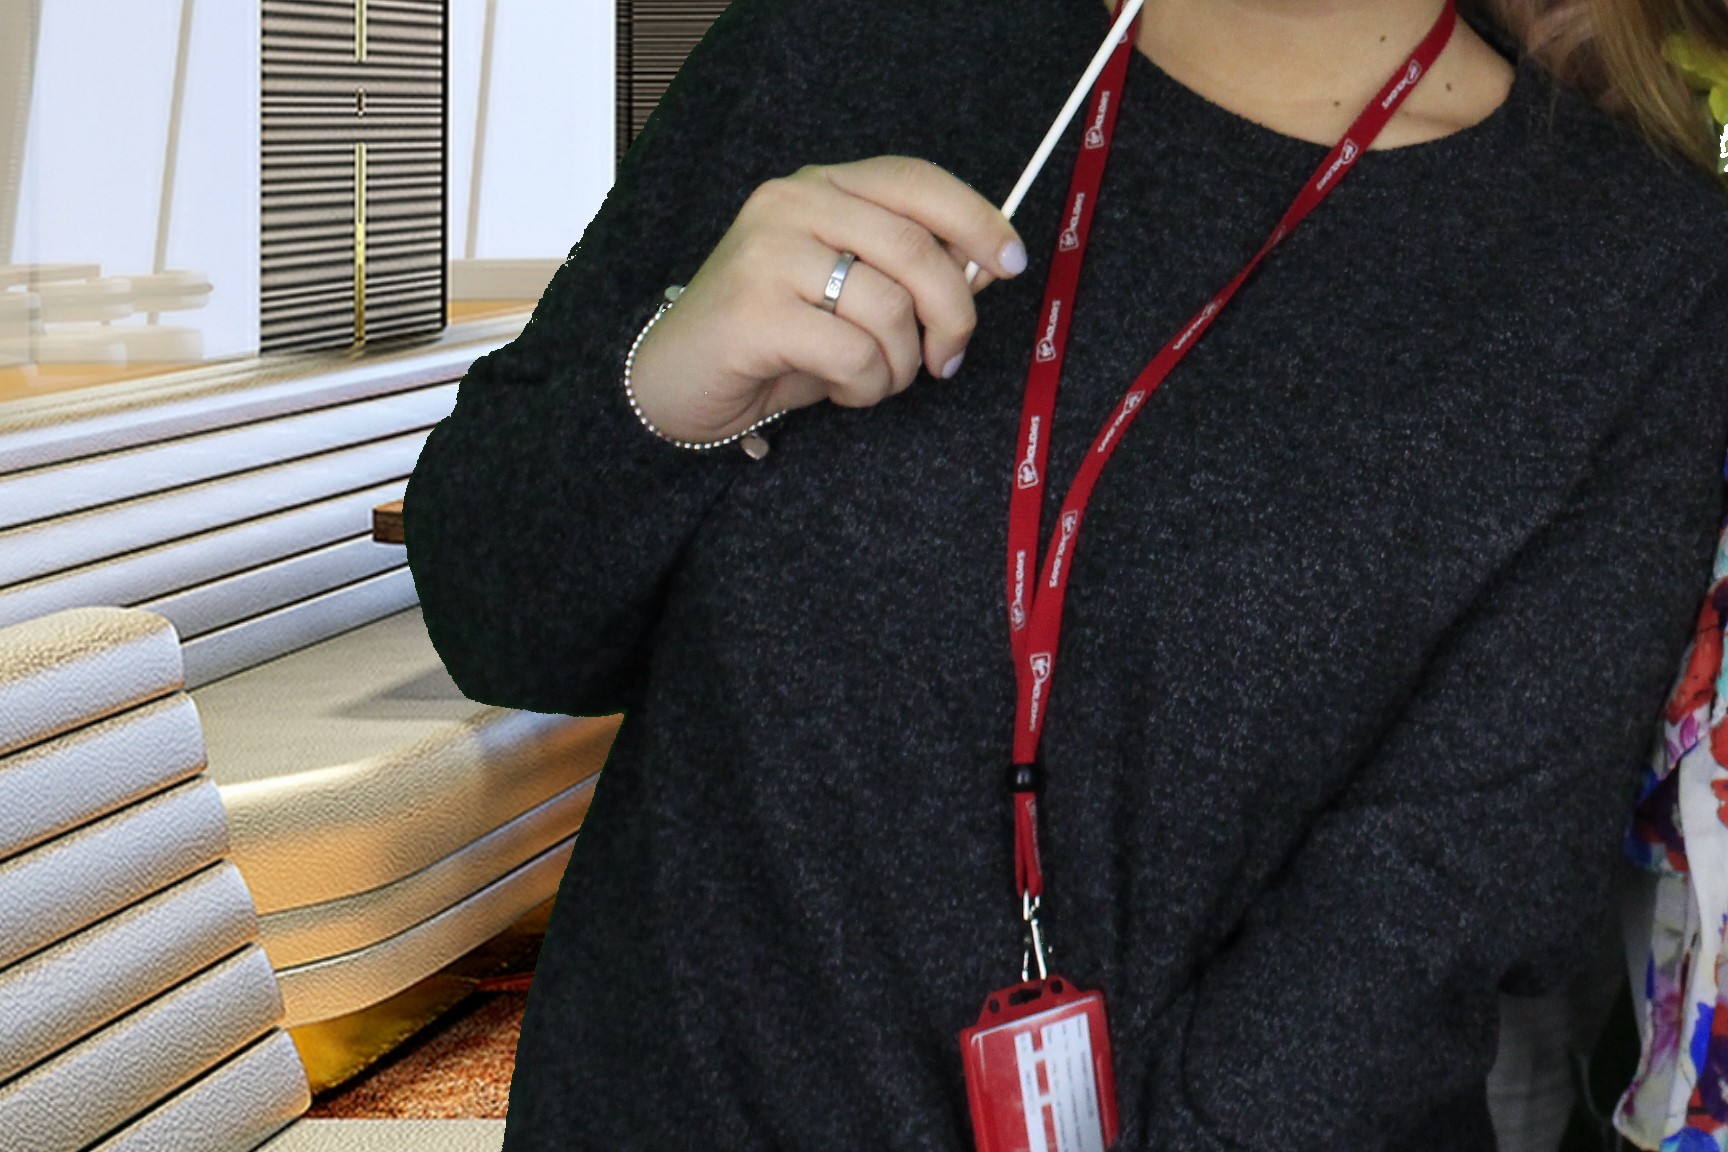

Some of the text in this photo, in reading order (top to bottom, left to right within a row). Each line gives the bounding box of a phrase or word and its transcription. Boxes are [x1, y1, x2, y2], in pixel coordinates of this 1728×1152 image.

[1095, 90, 1110, 128] HOLIDAYS
[1070, 192, 1085, 230] HOLIDAYS
[1046, 300, 1061, 340] HOLIDAYS
[1026, 415, 1040, 464] HOLIDAYS
[1015, 550, 1025, 603] HOLIDAYS
[1049, 535, 1069, 587] HOLIDAYS
